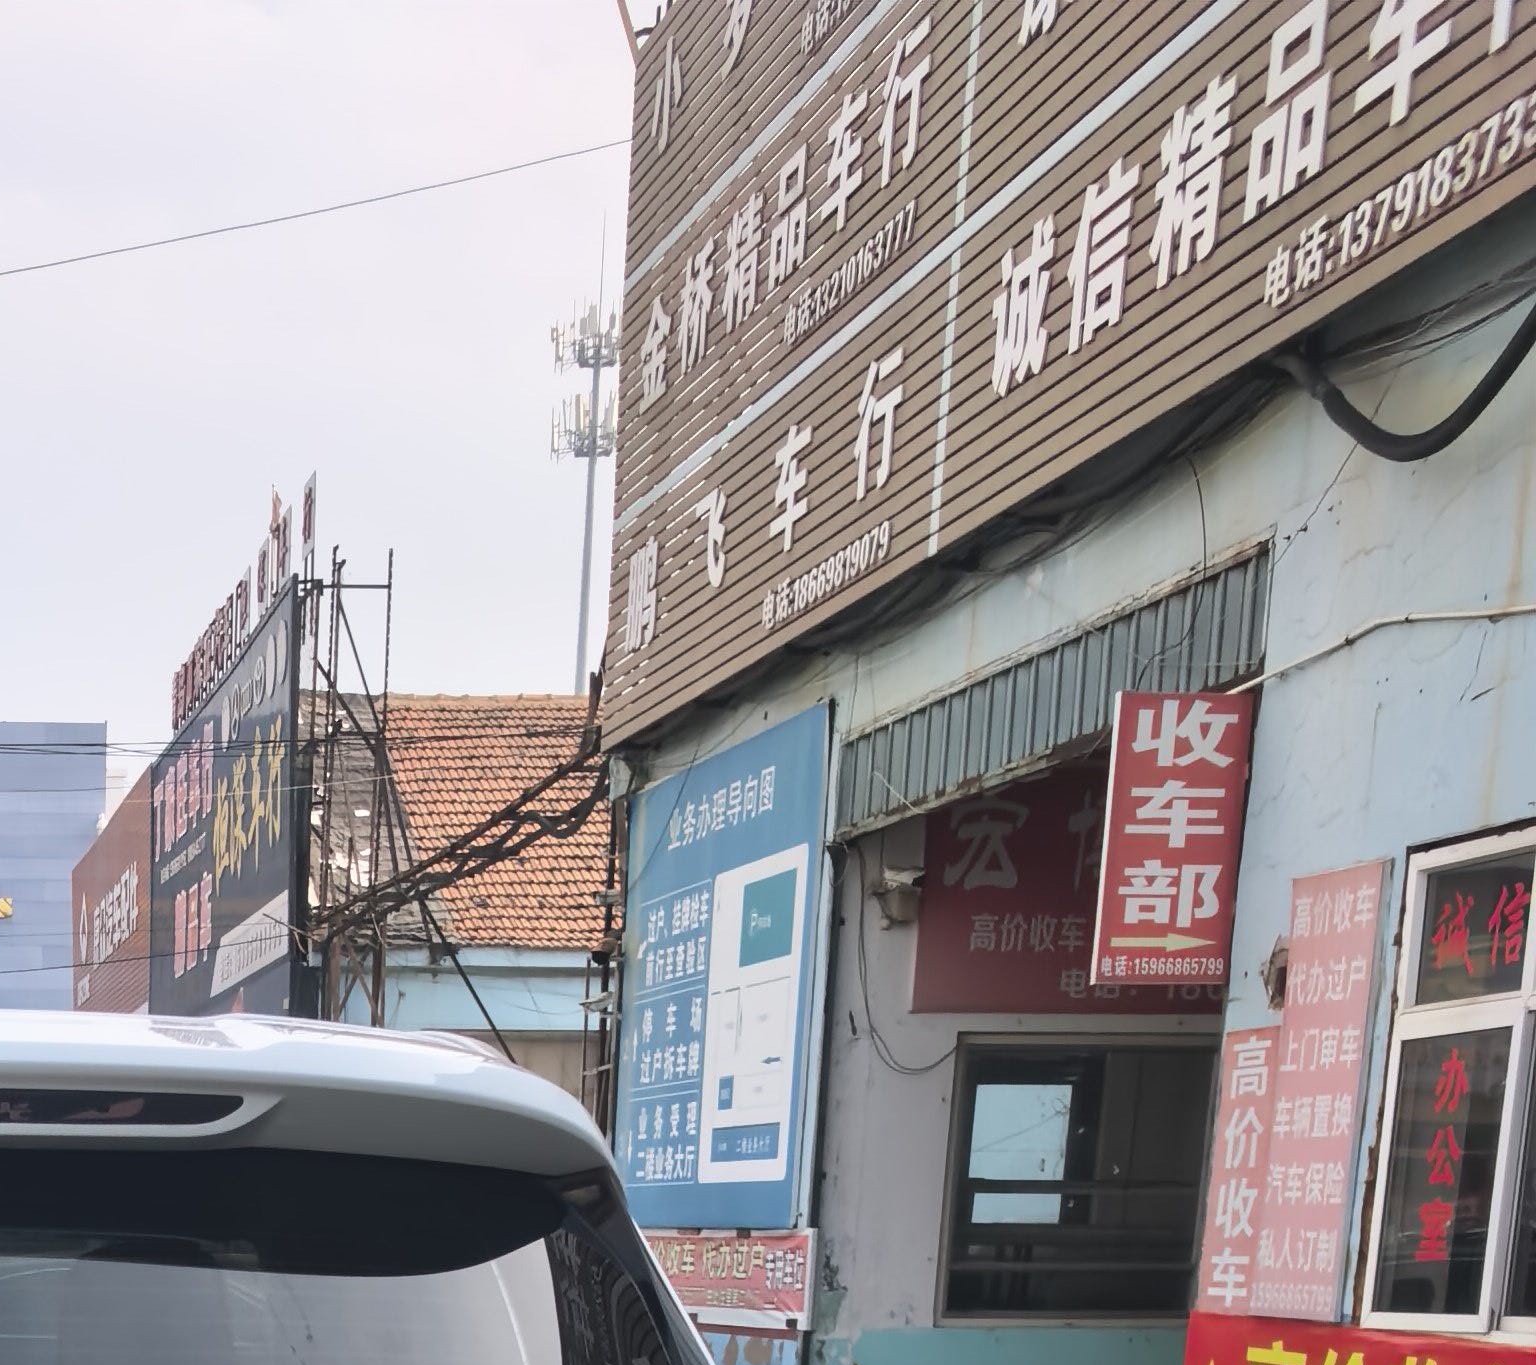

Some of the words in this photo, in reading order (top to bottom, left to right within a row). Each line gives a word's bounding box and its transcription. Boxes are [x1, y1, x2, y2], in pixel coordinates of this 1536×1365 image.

[640, 14, 932, 414] 金桥精品车行
[991, 0, 1513, 397] 诚信精品车
[668, 766, 776, 850] 业务办理导向图
[1117, 700, 1239, 928] 收车部
[969, 914, 1087, 952] 高价收车
[1293, 884, 1376, 939] 高价收车
[1432, 881, 1529, 974] 诚信
[1100, 955, 1225, 977] 电话:15966865799
[1288, 954, 1367, 1006] 代办过户
[642, 997, 702, 1043] 停车场
[1280, 1024, 1360, 1072] 上门审车
[1273, 1093, 1352, 1138] 车辆置换
[636, 1144, 695, 1181] 二楼业务大厅
[1207, 1035, 1272, 1308] 高价收车
[1415, 1047, 1470, 1262] 办公室
[1265, 1160, 1345, 1205] 汽车保险
[704, 1240, 765, 1279] 代办过户
[1257, 1227, 1337, 1272] 私人订制
